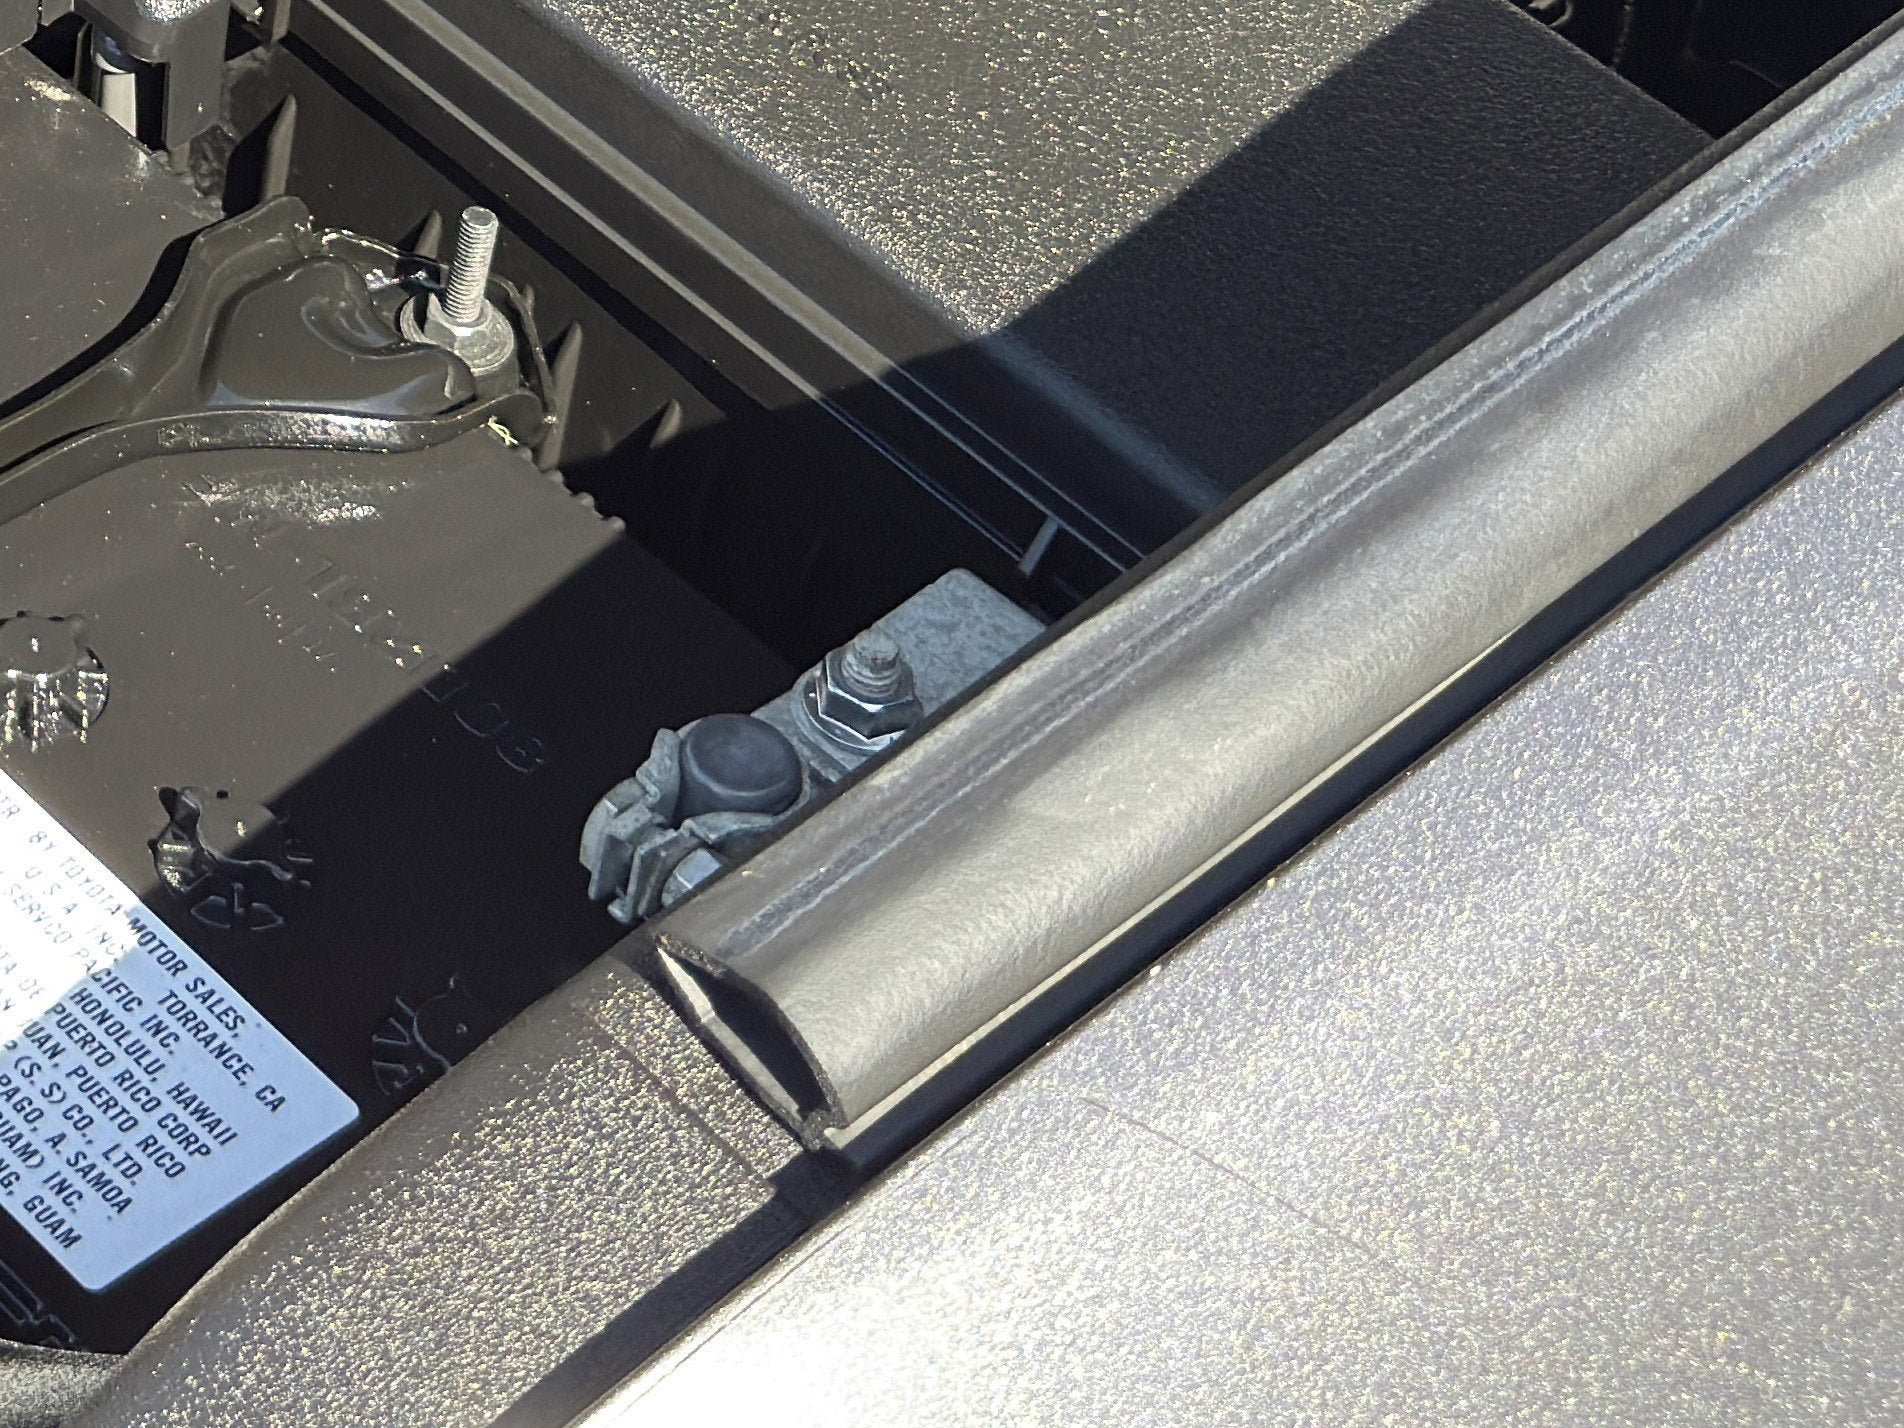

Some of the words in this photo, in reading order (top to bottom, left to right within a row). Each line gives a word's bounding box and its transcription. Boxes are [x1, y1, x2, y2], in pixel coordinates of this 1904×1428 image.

[3, 883, 73, 944] SERVCO
[71, 947, 144, 1013] PACIFIC
[140, 1013, 181, 1056] INC.
[29, 830, 56, 852] BY
[59, 856, 124, 916] TOYOTA
[127, 916, 188, 978] MOTOR
[185, 976, 246, 1039] SALES,
[44, 1002, 116, 1068] PUERTO
[112, 1067, 162, 1114] RICO
[156, 1111, 213, 1158] CORP
[69, 987, 166, 1083] HONOLULU,
[165, 1081, 239, 1146] HAWAII
[157, 989, 255, 1087] TORRANCE,
[254, 1084, 287, 1113] CA
[44, 1131, 68, 1155] A.
[65, 1150, 133, 1214] SAMOA
[65, 1064, 139, 1134] PUERTO
[134, 1133, 187, 1179] RICO
[101, 1142, 143, 1186] LTD.
[22, 1194, 83, 1249] GUAM
[41, 1170, 84, 1213] INC.
